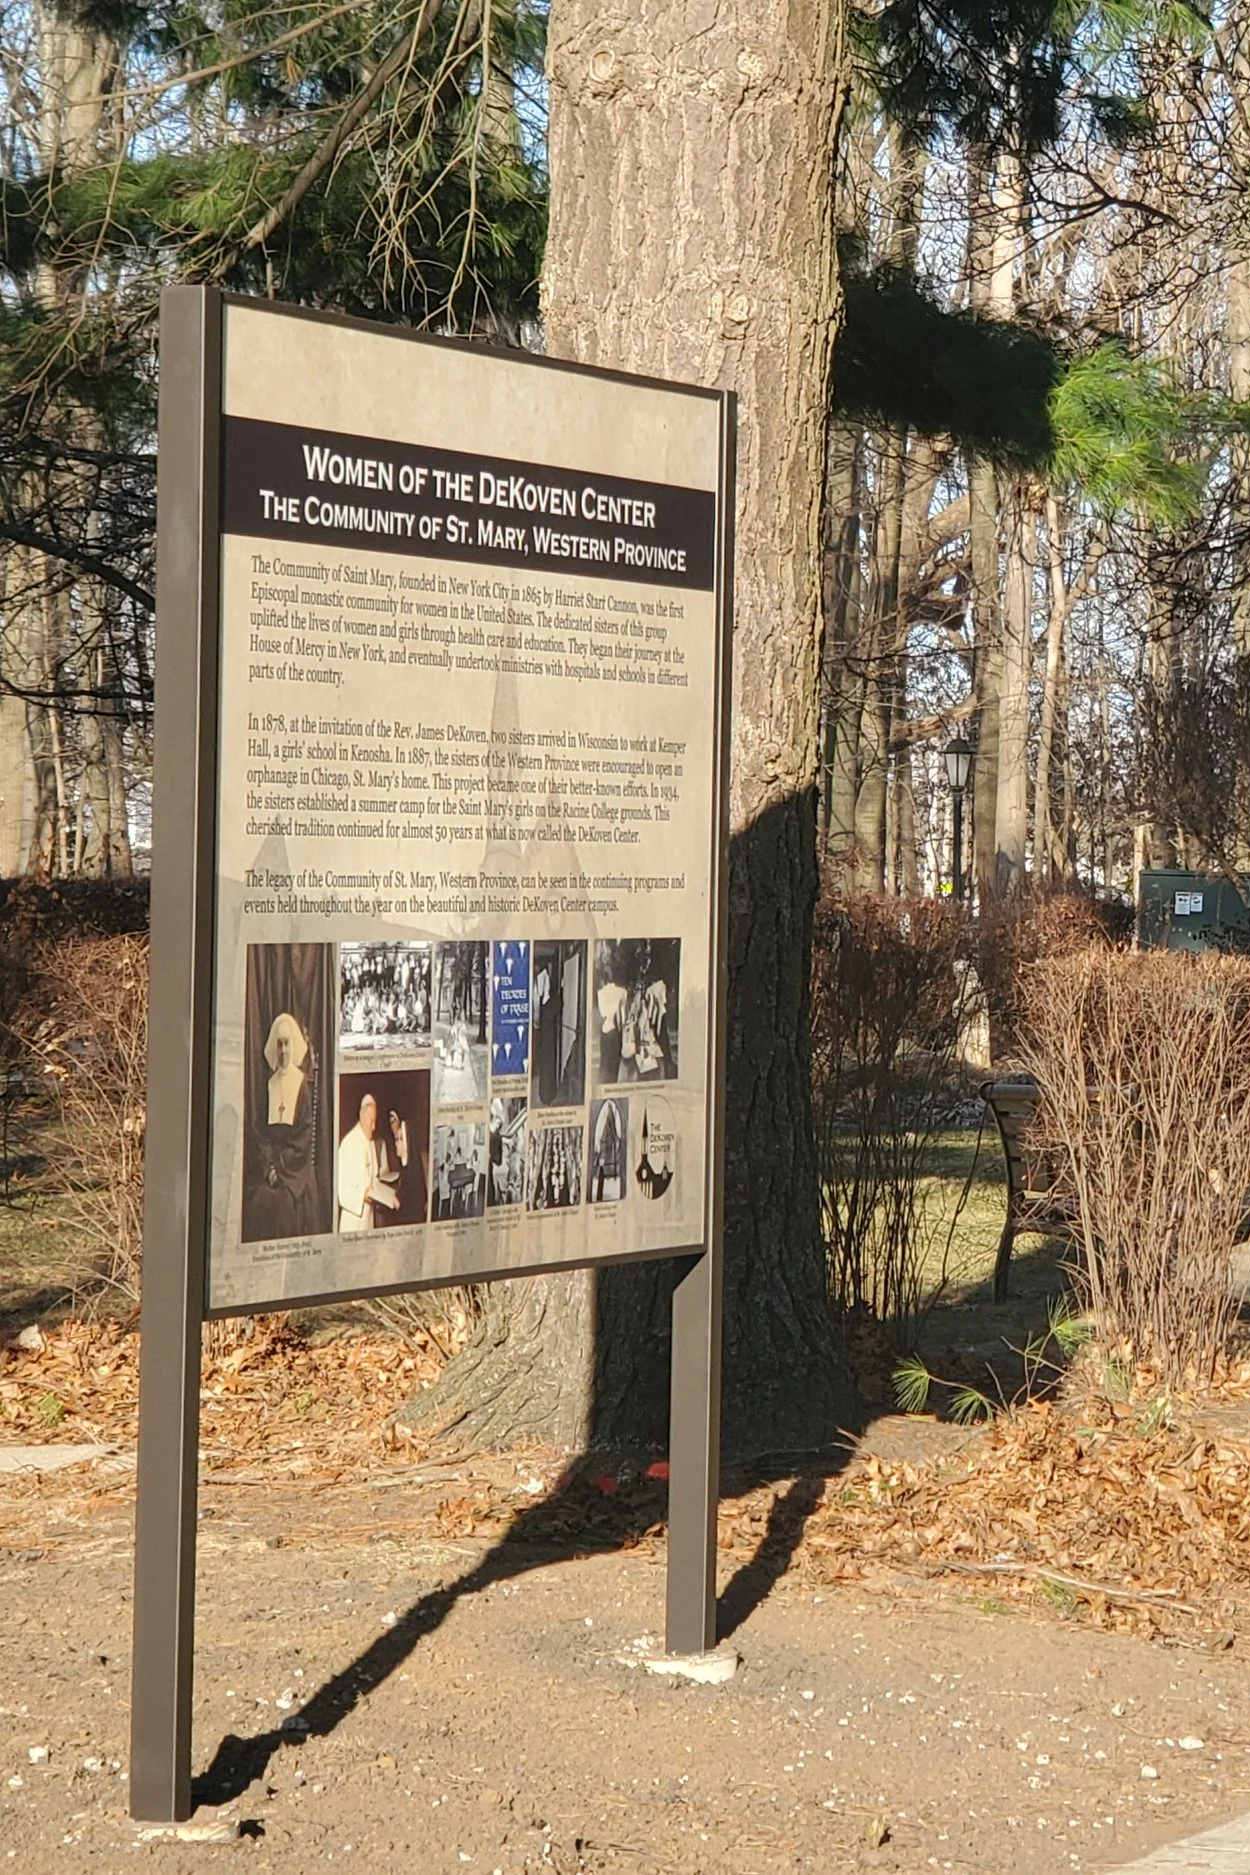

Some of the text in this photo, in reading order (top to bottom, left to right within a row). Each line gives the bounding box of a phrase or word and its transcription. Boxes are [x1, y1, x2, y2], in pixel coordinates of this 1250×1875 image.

[251, 554, 271, 574] The
[272, 557, 330, 585] Community
[331, 564, 342, 582] of
[343, 565, 368, 585] Saint
[369, 568, 397, 592] Mary,
[398, 571, 436, 592] founded
[437, 575, 447, 593] in
[448, 577, 469, 596] New
[470, 579, 491, 598] York
[492, 581, 509, 604] City
[510, 584, 520, 601] in
[521, 586, 542, 607] 1865
[542, 587, 553, 609] by
[251, 581, 299, 607] Episcopal
[300, 590, 344, 608] monastic
[345, 595, 398, 617] community
[400, 596, 413, 615] for
[415, 602, 448, 618] women
[449, 601, 459, 619] in
[460, 603, 475, 621] the
[476, 604, 506, 624] United
[536, 610, 552, 628] The
[250, 608, 289, 630] uplifted
[290, 611, 307, 630] the
[308, 612, 330, 632] lives
[331, 615, 343, 633] of
[343, 620, 378, 636] women
[379, 620, 397, 638] and
[398, 622, 419, 643] girls
[420, 623, 456, 647] through
[457, 627, 485, 646] health
[486, 634, 505, 648] care
[505, 632, 523, 649] and
[249, 633, 543, 675] House of Mercy in New York, and eventually undertook ministries
[248, 662, 345, 688] parts of the country.
[248, 712, 259, 730] In
[261, 713, 288, 736] 1878,
[289, 717, 299, 733] at
[301, 715, 317, 734] the
[318, 716, 363, 736] invitation
[364, 719, 375, 737] of
[376, 720, 392, 738] the
[393, 721, 414, 739] Rev.
[415, 722, 445, 741] James
[490, 728, 507, 744] two
[508, 728, 536, 746] sisters
[247, 738, 272, 761] Hall,
[273, 744, 280, 757] a
[306, 742, 337, 760] school
[338, 743, 349, 761] in
[350, 743, 393, 763] Kenosha.
[395, 746, 406, 763] In
[408, 747, 433, 768] 1887,
[434, 748, 449, 765] the
[450, 749, 480, 767] sisters
[480, 751, 491, 767] of
[491, 751, 506, 768] the
[507, 752, 543, 770] Western
[246, 765, 298, 788] orphanage
[299, 767, 310, 785] in
[310, 767, 351, 790] Chicago,
[352, 769, 365, 787] St.
[401, 771, 430, 789] home.
[432, 772, 452, 790] This
[453, 774, 485, 795] project
[486, 775, 519, 792] became
[520, 780, 536, 793] one
[537, 777, 547, 793] of
[246, 791, 263, 809] the
[264, 791, 295, 810] sisters
[296, 793, 349, 812] established
[350, 799, 357, 812] a
[358, 799, 397, 813] summer
[399, 800, 425, 818] camp
[426, 797, 440, 814] for
[442, 798, 457, 815] the
[458, 798, 482, 815] Saint
[514, 800, 534, 821] girls
[535, 805, 546, 817] on
[245, 817, 484, 843] cherished tradition continued for almost 50 years at
[244, 869, 264, 887] The
[265, 869, 295, 891] legacy
[296, 870, 307, 887] of
[307, 870, 323, 887] the
[324, 870, 381, 892] Community
[382, 871, 393, 888] of
[394, 871, 407, 888] St.
[409, 871, 437, 892] Mary,
[439, 871, 478, 888] Western
[243, 896, 520, 917] events held throughout the year the beautiful and historic
